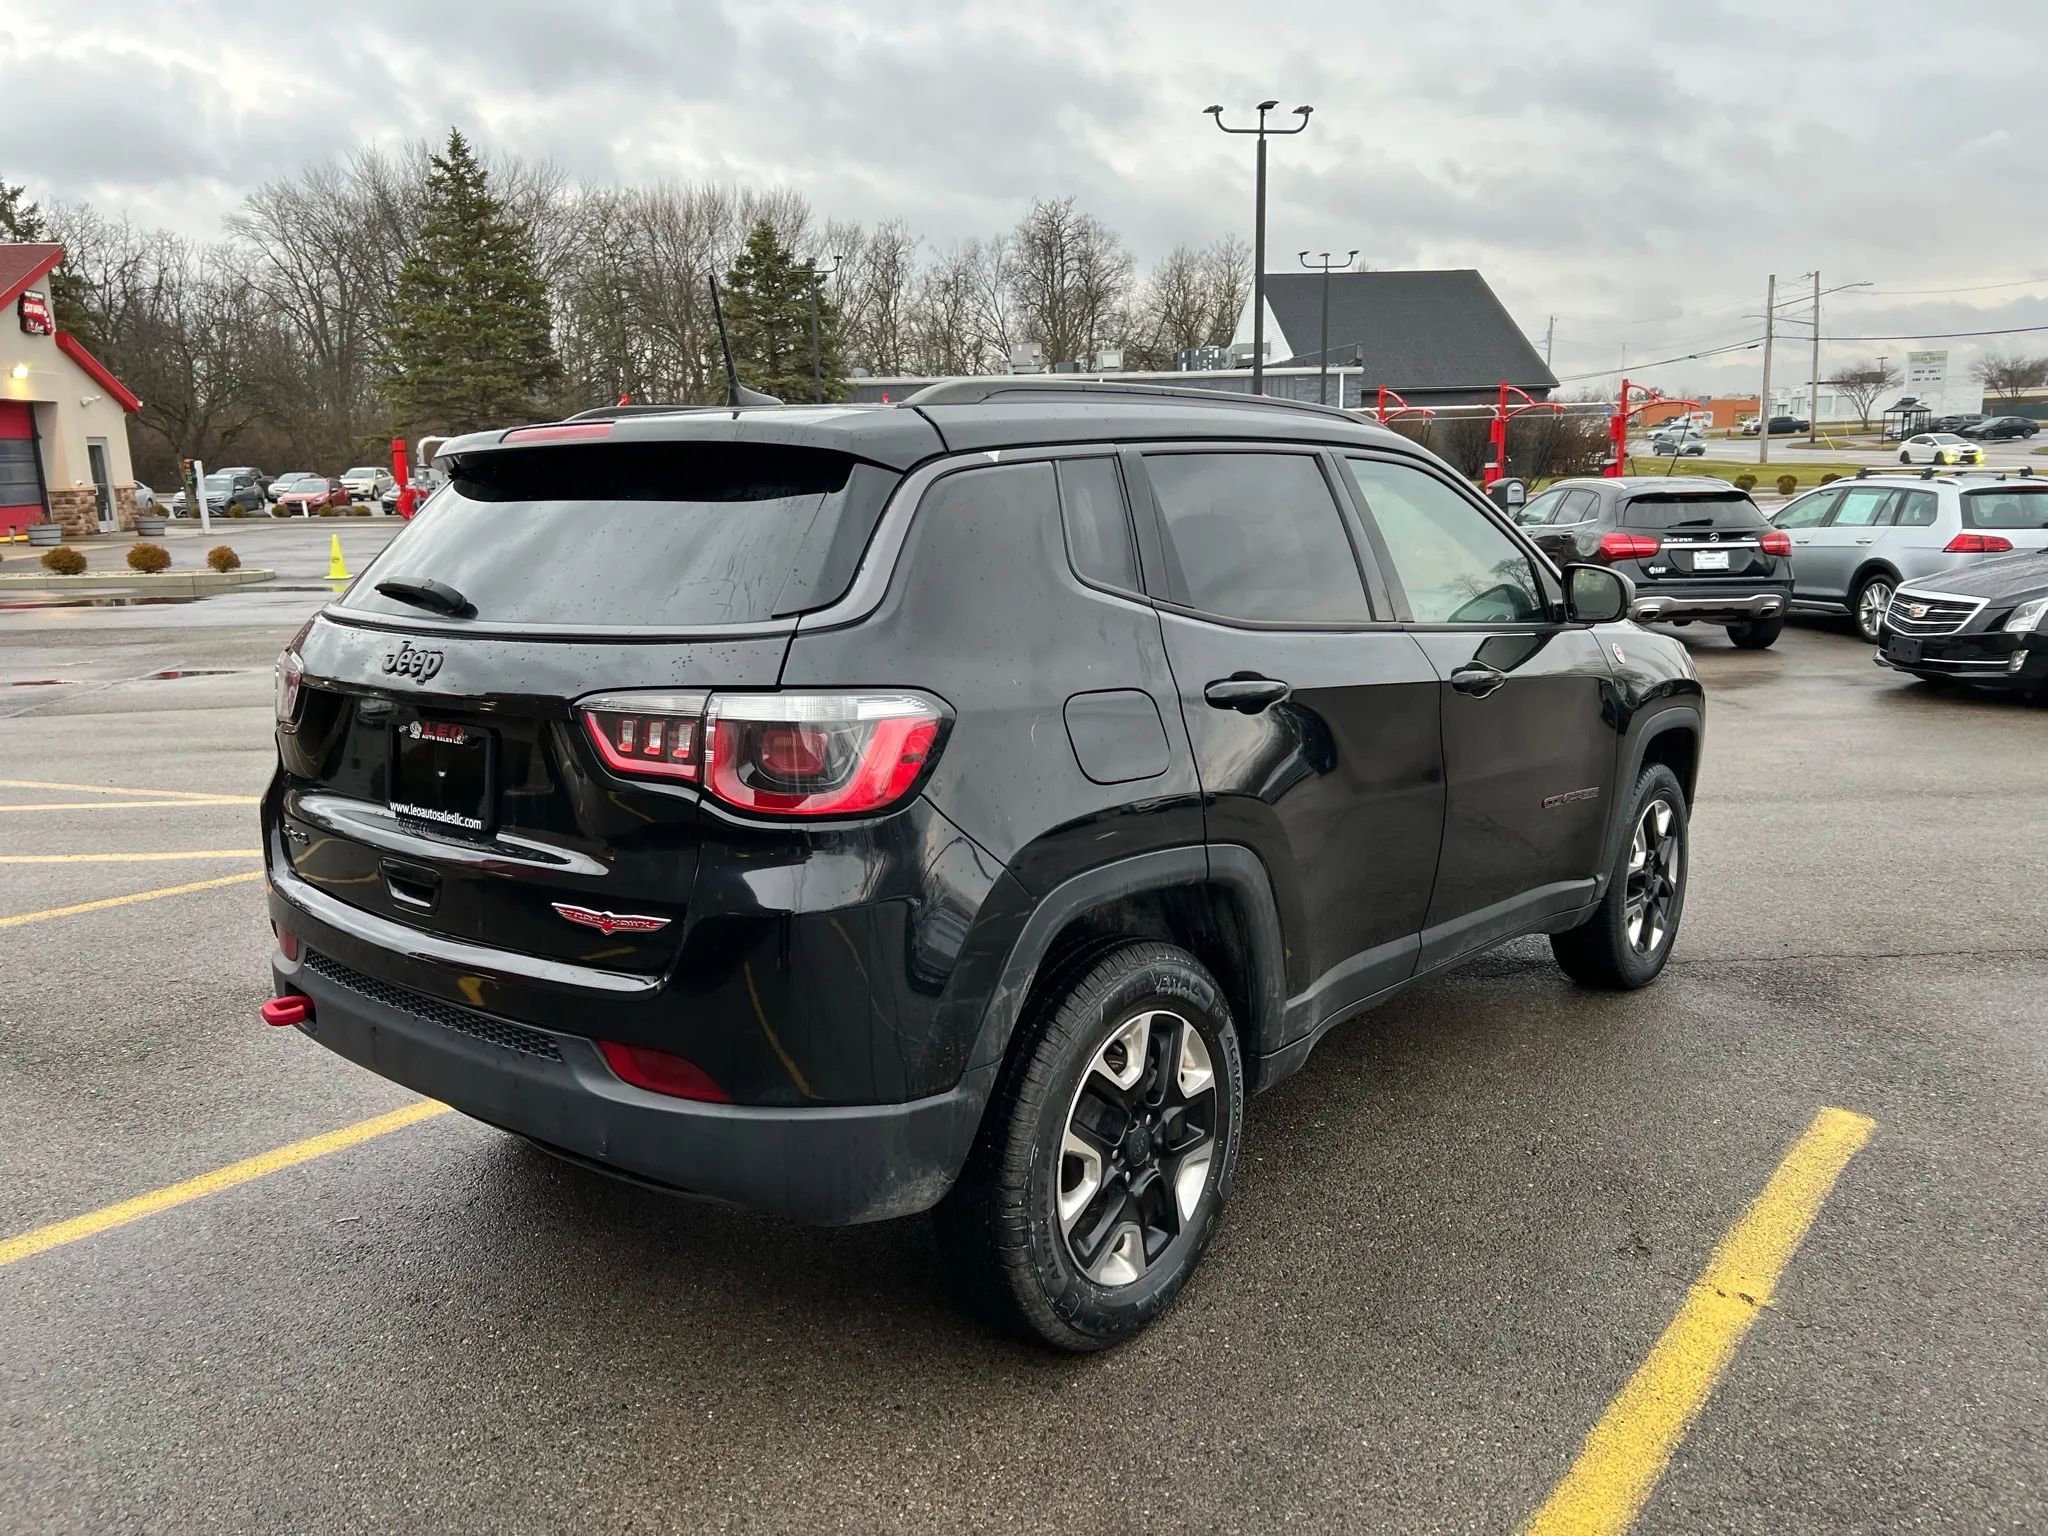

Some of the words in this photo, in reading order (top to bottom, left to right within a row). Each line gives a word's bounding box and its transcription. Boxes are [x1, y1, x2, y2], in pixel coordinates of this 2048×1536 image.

[382, 641, 444, 686] Jeep
[423, 721, 465, 738] LEO
[389, 801, 482, 831] www.leoautosalesllc.com
